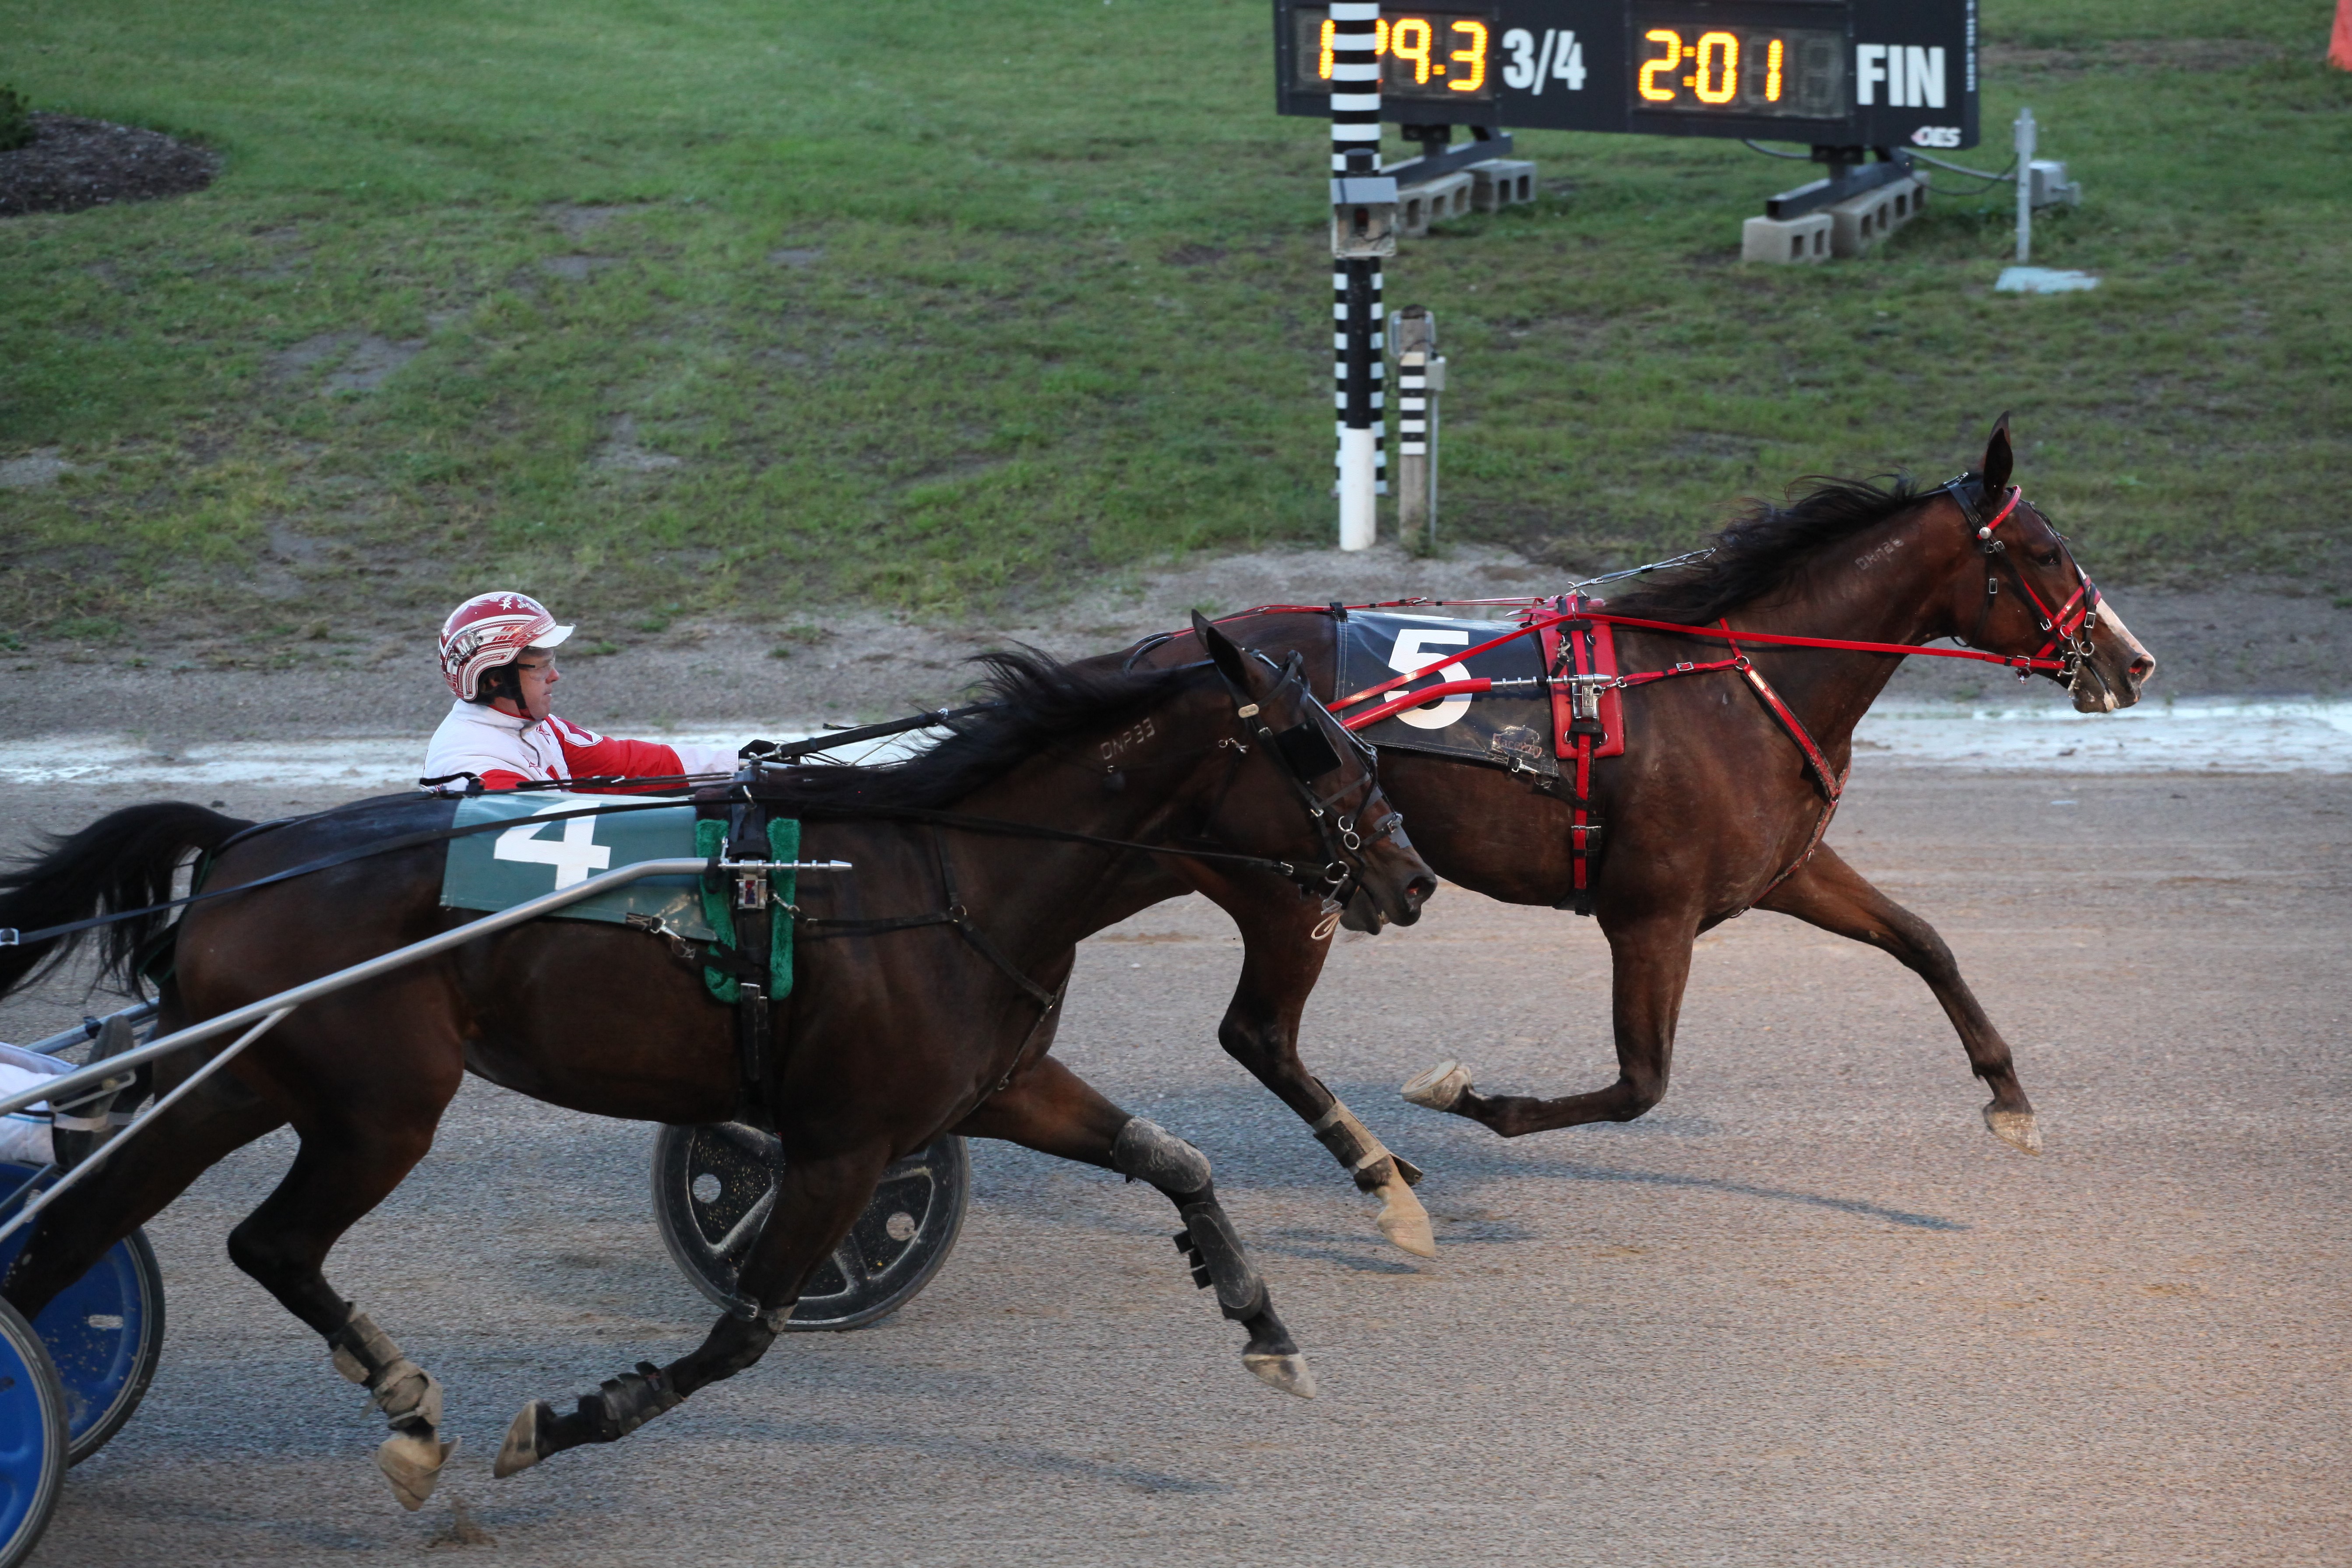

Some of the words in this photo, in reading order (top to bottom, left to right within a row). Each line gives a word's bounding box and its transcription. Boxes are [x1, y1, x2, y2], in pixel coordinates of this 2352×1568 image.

[1502, 27, 1587, 96] 3/4
[1638, 29, 1783, 103] 2:01
[1856, 43, 1945, 108] FIN
[454, 637, 471, 656] M
[1384, 629, 1473, 729] 5
[493, 799, 611, 891] 4
